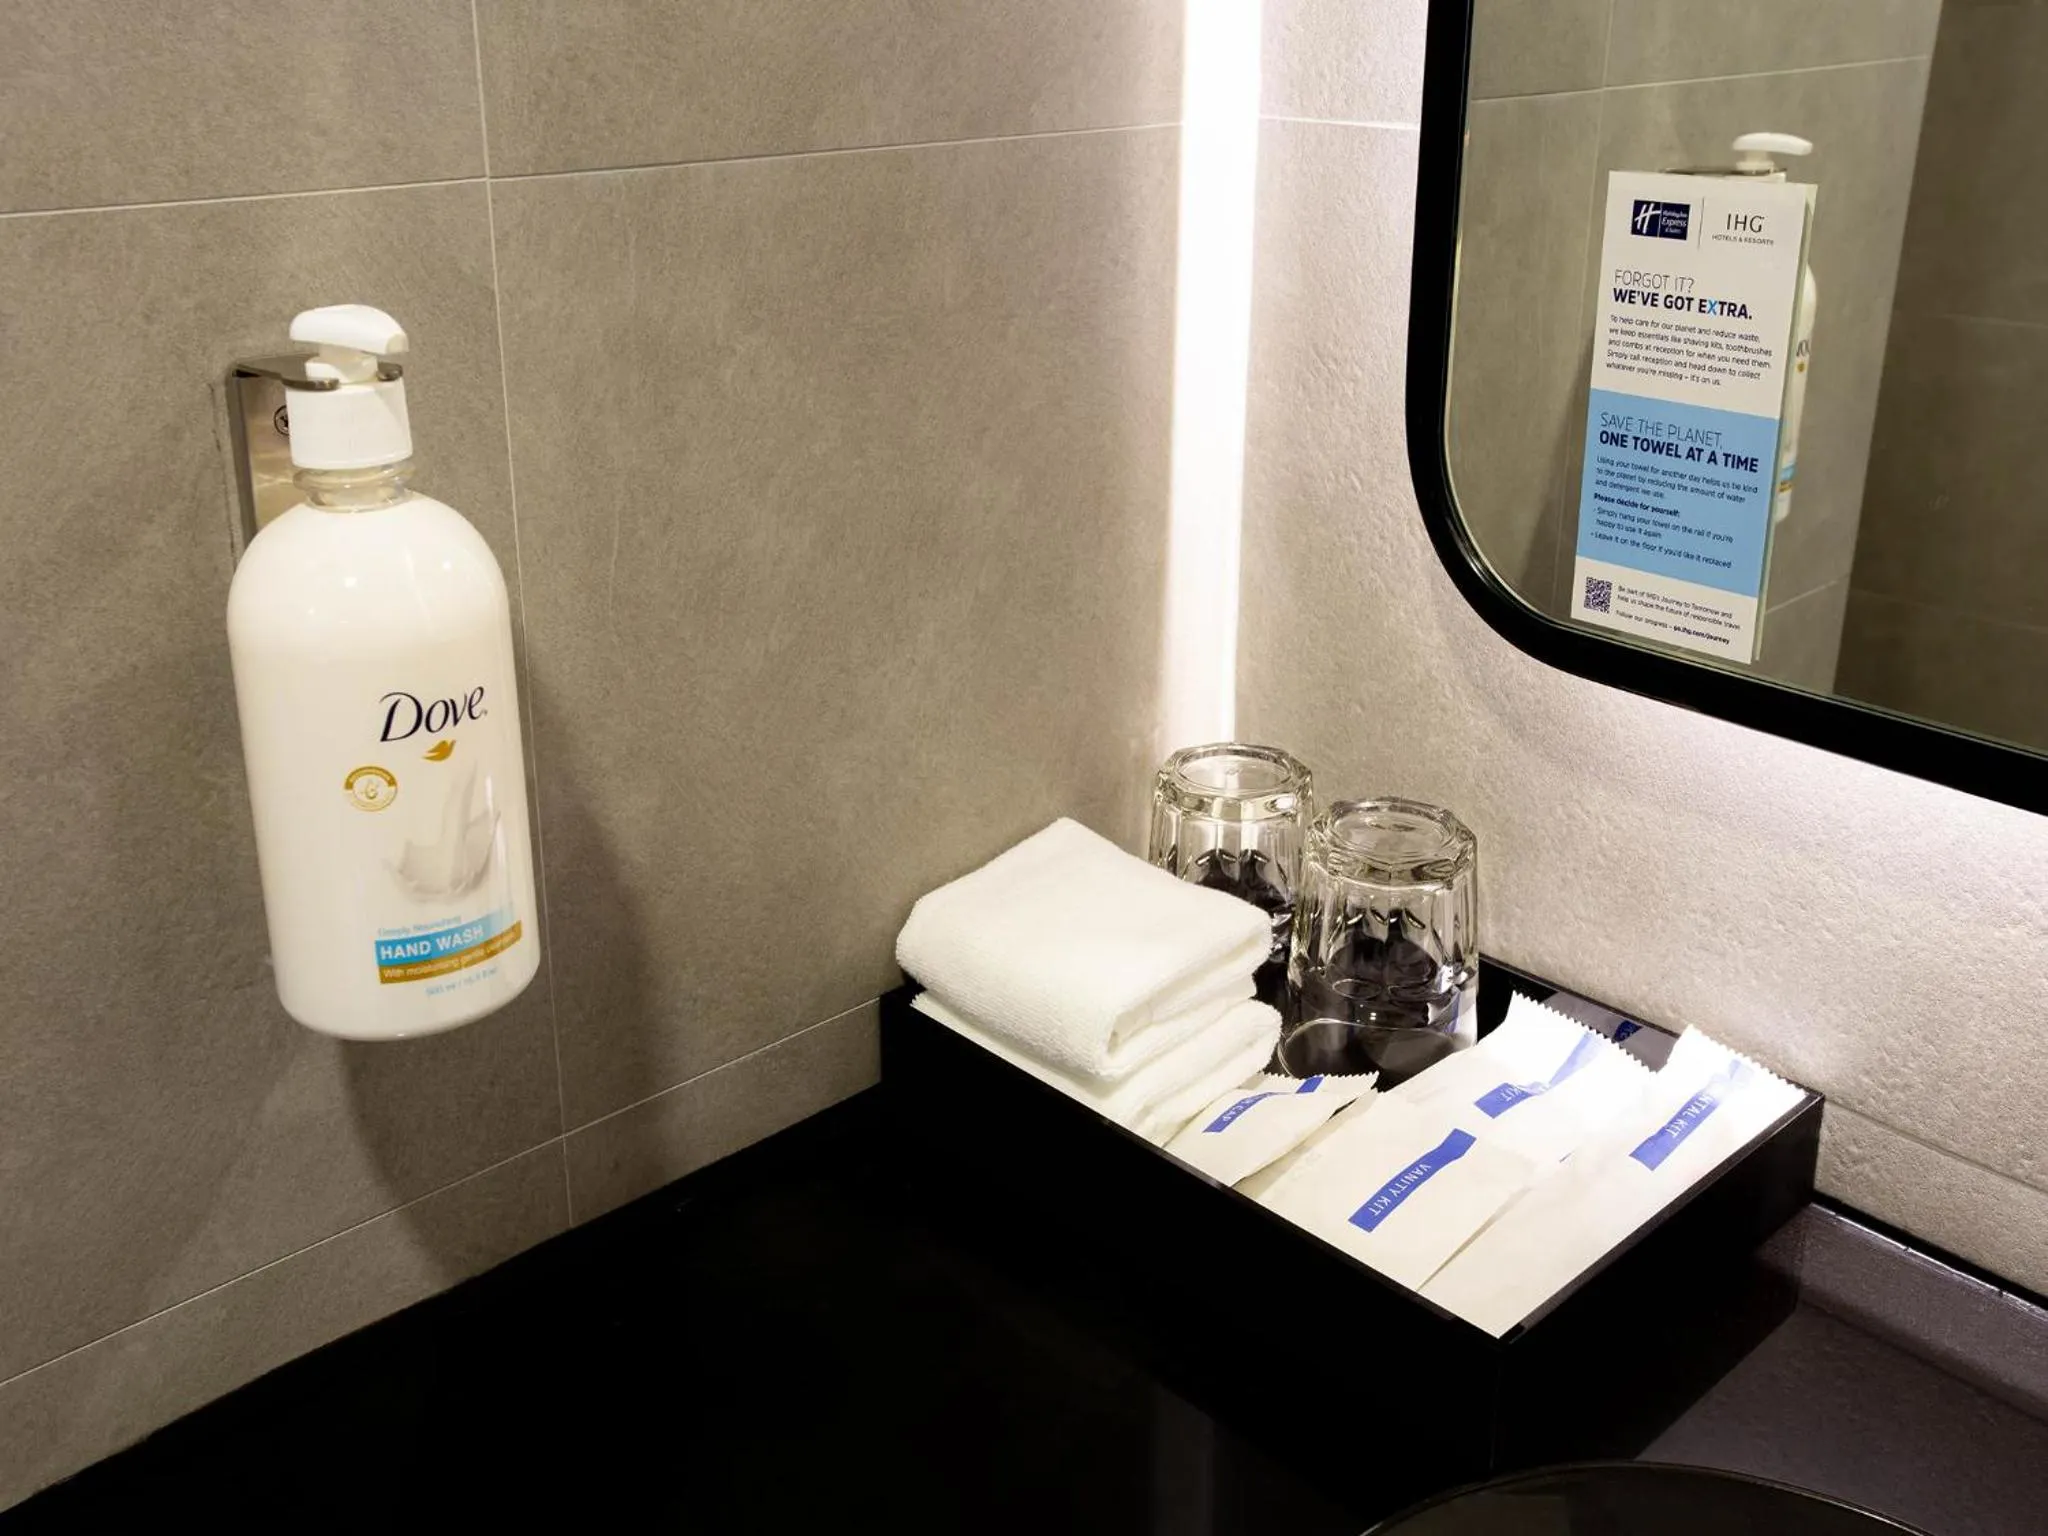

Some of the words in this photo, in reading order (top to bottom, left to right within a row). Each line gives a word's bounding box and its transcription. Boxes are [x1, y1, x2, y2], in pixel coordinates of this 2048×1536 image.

[1661, 217, 1687, 228] Express
[1726, 213, 1765, 234] IHG
[1711, 234, 1737, 243] HOTELS
[1744, 236, 1775, 246] RESORTS
[1614, 270, 1669, 290] FORGOT
[1674, 277, 1694, 293] IT?
[1613, 288, 1659, 307] WE'VE
[1664, 294, 1694, 311] GOT
[1699, 299, 1753, 320] EXTRA.
[1611, 315, 1618, 323] To
[1619, 317, 1634, 325] help
[1636, 319, 1649, 327] care
[1651, 320, 1660, 328] for
[1675, 324, 1697, 334] planet
[1712, 330, 1737, 339] reduce
[1621, 328, 1637, 337] keep
[1638, 332, 1669, 342] essentials
[1671, 335, 1681, 343] like
[1683, 337, 1709, 349] shaving
[1726, 344, 1773, 357] toothbrushes
[1622, 340, 1644, 350] combs
[1653, 345, 1685, 356] reception
[1686, 349, 1696, 357] for
[1697, 352, 1716, 360] when
[1732, 357, 1750, 366] need
[1606, 362, 1636, 372] whatever
[1659, 370, 1683, 381] missing
[1608, 349, 1628, 360] Simply
[1642, 356, 1673, 366] reception
[1674, 360, 1688, 369] and
[1689, 362, 1706, 371] head
[1708, 365, 1728, 374] down
[1729, 368, 1737, 376] to
[1738, 370, 1761, 380] collect
[1601, 412, 1632, 432] SAVE
[1638, 419, 1663, 438] THE
[1600, 430, 1628, 449] ONE
[1633, 436, 1682, 459] TOWEL
[1686, 446, 1704, 463] AT
[1707, 451, 1719, 466] A
[1723, 453, 1759, 473] TIME
[1596, 479, 1608, 487] and
[1609, 482, 1640, 493] detergent
[1597, 456, 1615, 466] Using
[1631, 463, 1650, 473] towel
[1651, 466, 1660, 474] for
[1662, 469, 1687, 480] another
[1689, 474, 1701, 483] day
[1702, 477, 1721, 487] helps
[1732, 483, 1741, 491] be
[1743, 484, 1758, 494] kind
[1604, 469, 1615, 477] the
[1617, 472, 1637, 481] planet
[1638, 476, 1646, 484] by
[1648, 479, 1676, 490] reducing
[1677, 483, 1688, 492] the
[1690, 487, 1716, 497] amount
[1726, 494, 1746, 503] water
[1594, 493, 1615, 503] Please
[1617, 498, 1639, 508] decide
[1640, 502, 1650, 510] for
[1596, 519, 1616, 529] happy
[1643, 529, 1662, 539] again
[1597, 507, 1618, 518] Simply
[1619, 513, 1636, 522] hang
[1652, 520, 1671, 529] towel
[1682, 526, 1693, 534] the
[1694, 529, 1705, 537] rail
[1595, 532, 1613, 542] Leave
[1630, 540, 1640, 548] the
[1642, 542, 1657, 551] floor
[1683, 551, 1695, 560] like
[1696, 554, 1701, 562] it
[1703, 556, 1732, 568] replaced
[379, 686, 485, 743] Dove
[380, 940, 432, 960] HAND
[436, 924, 484, 951] WASH
[1665, 1119, 1689, 1138] KIT
[1388, 1164, 1432, 1198] VANITY
[1368, 1196, 1392, 1216] KIT
